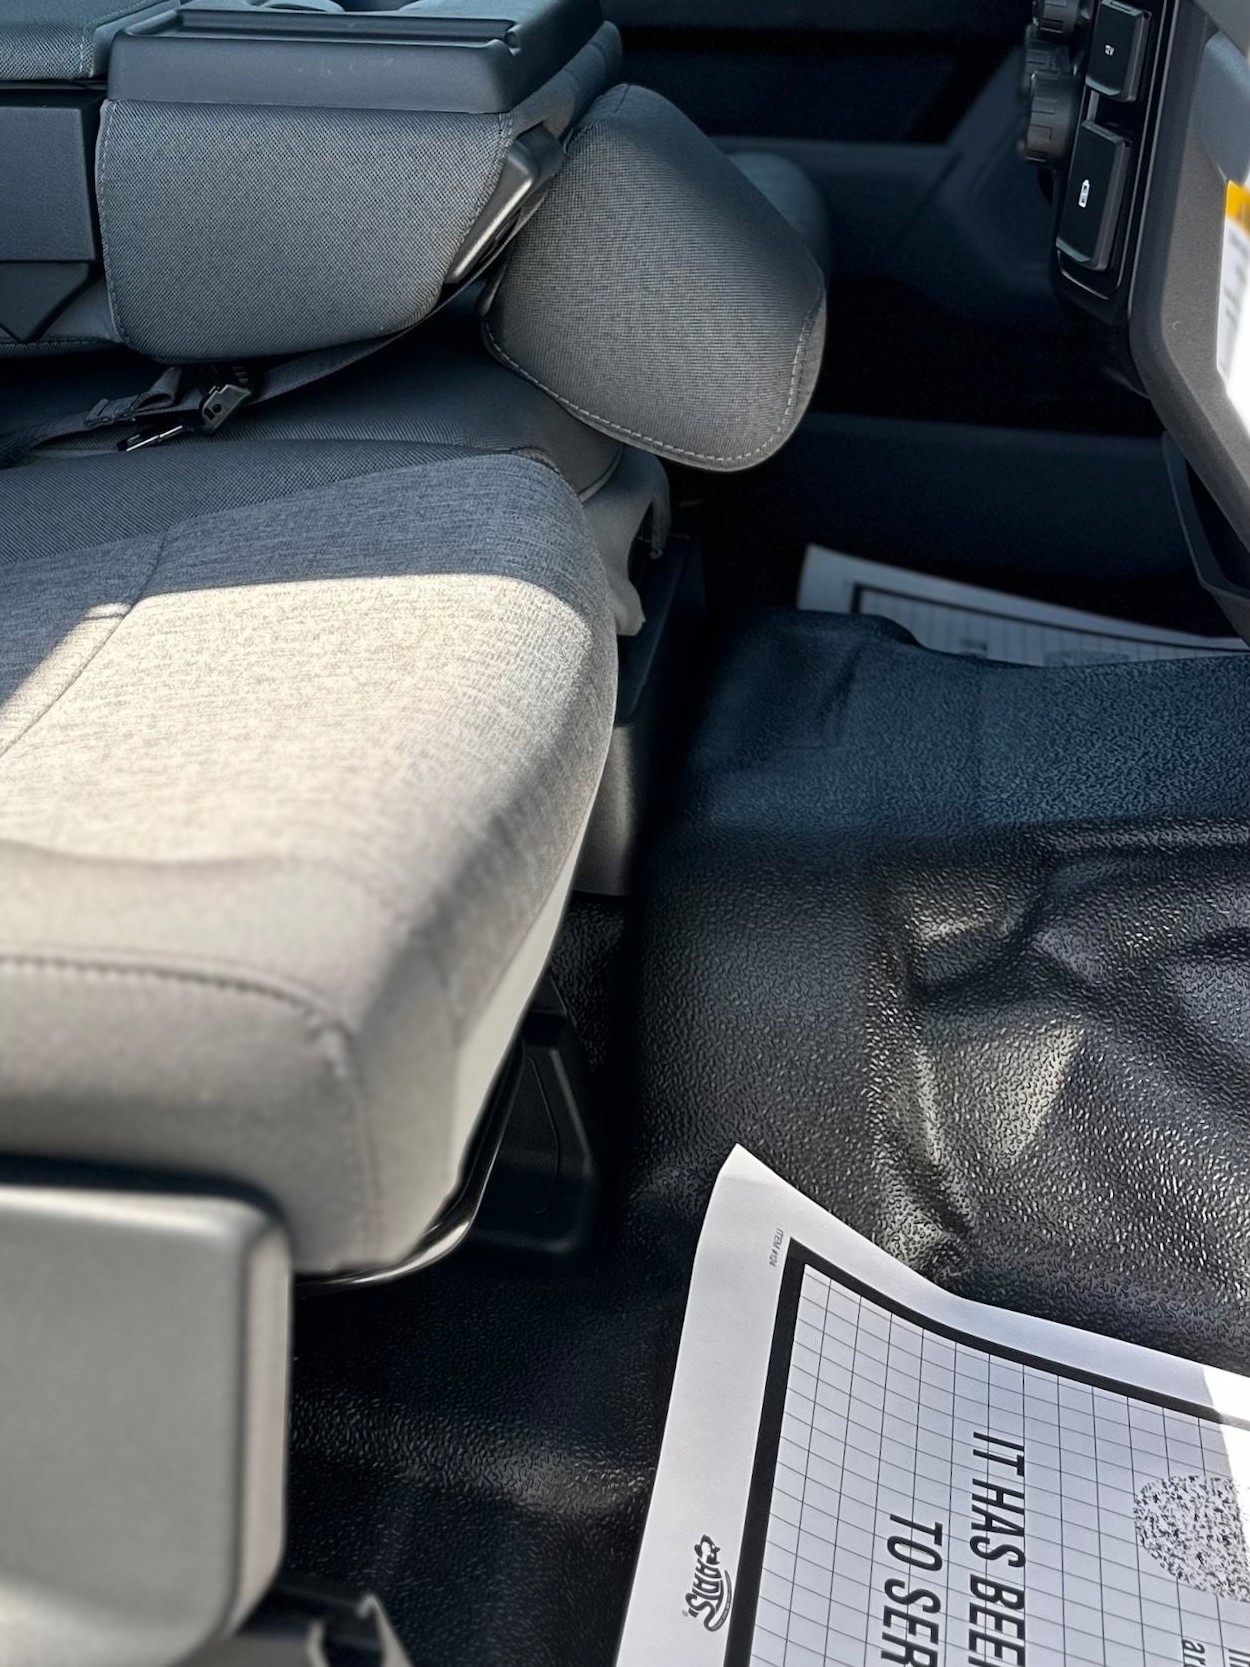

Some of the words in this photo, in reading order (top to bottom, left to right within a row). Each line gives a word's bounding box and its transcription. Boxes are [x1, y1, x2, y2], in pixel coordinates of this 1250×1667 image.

[773, 1227, 784, 1249] ITEM
[973, 1431, 1025, 1477] IT
[886, 1514, 943, 1572] TO
[969, 1477, 1026, 1568] HAS
